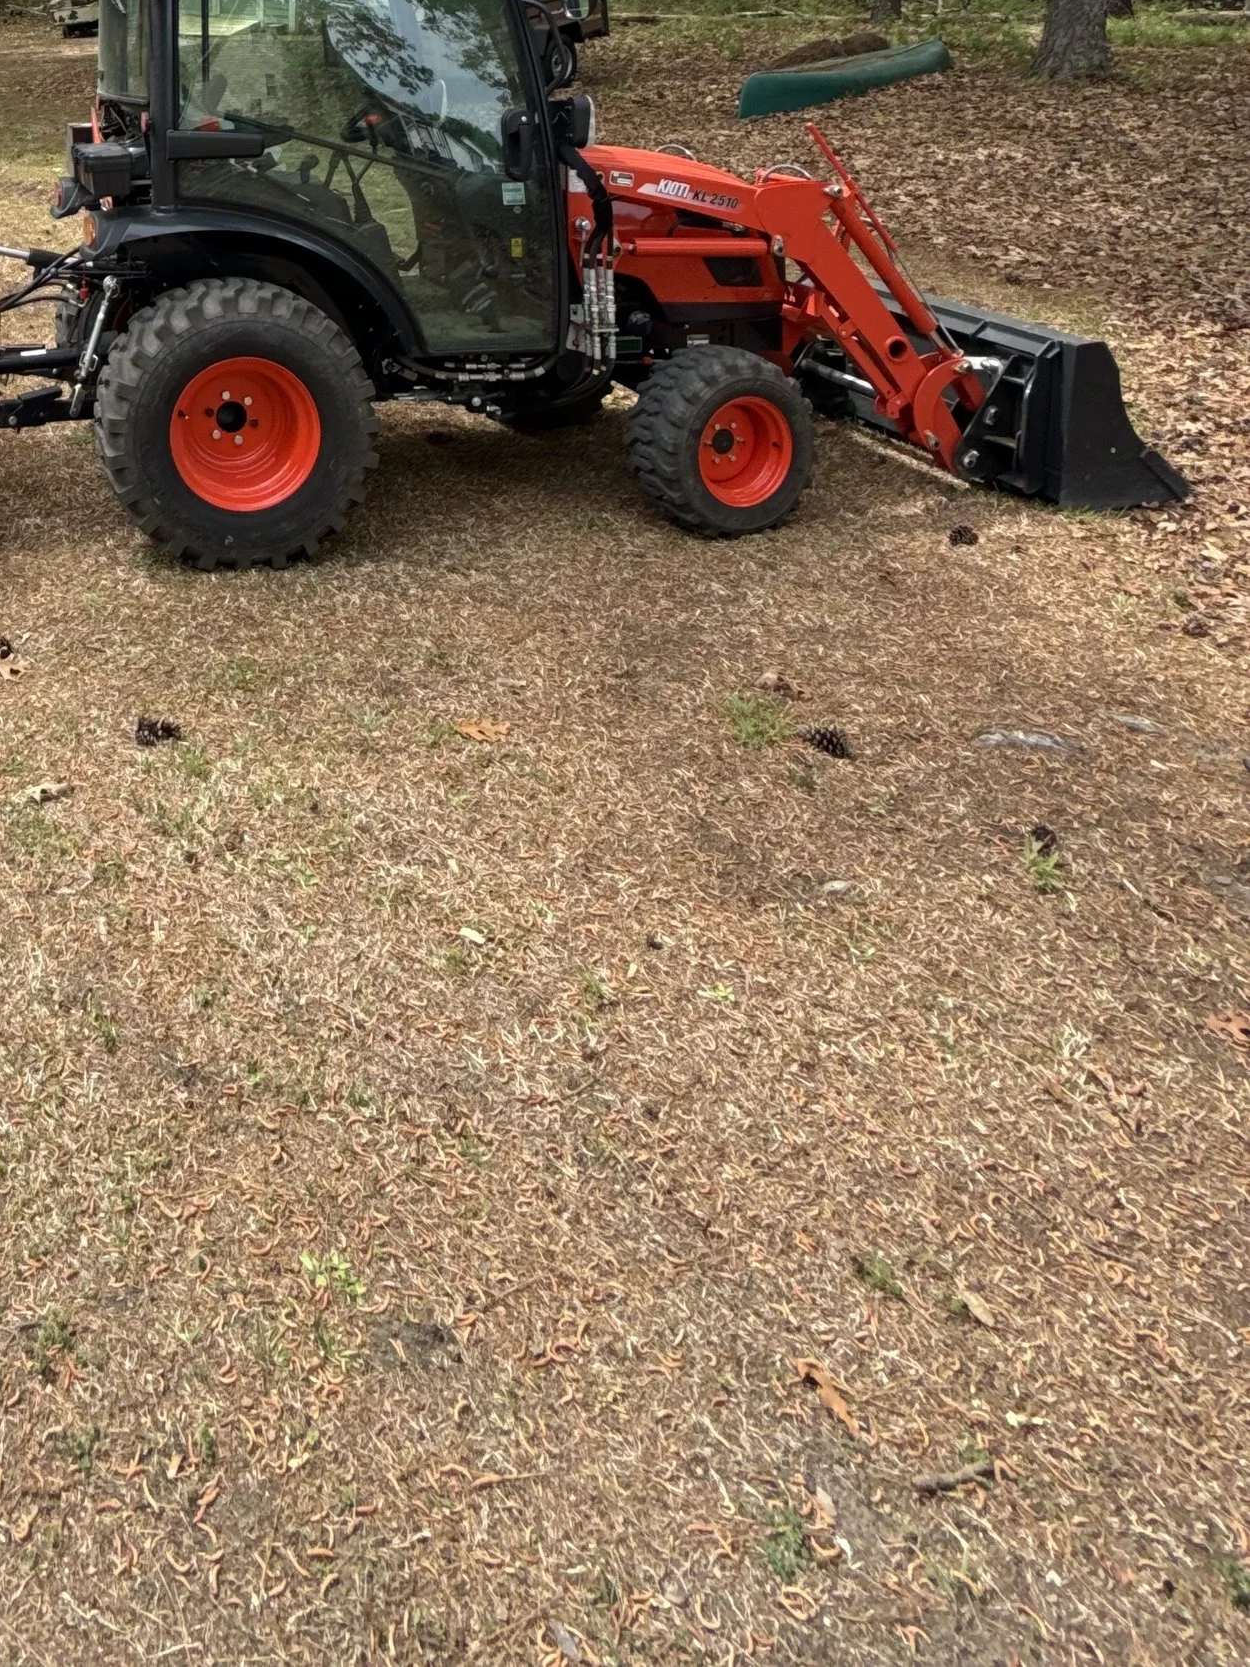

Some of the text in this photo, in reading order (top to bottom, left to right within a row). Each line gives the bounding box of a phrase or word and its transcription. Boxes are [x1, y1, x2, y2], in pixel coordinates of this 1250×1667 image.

[657, 178, 739, 209] KIOTI KL 2510
